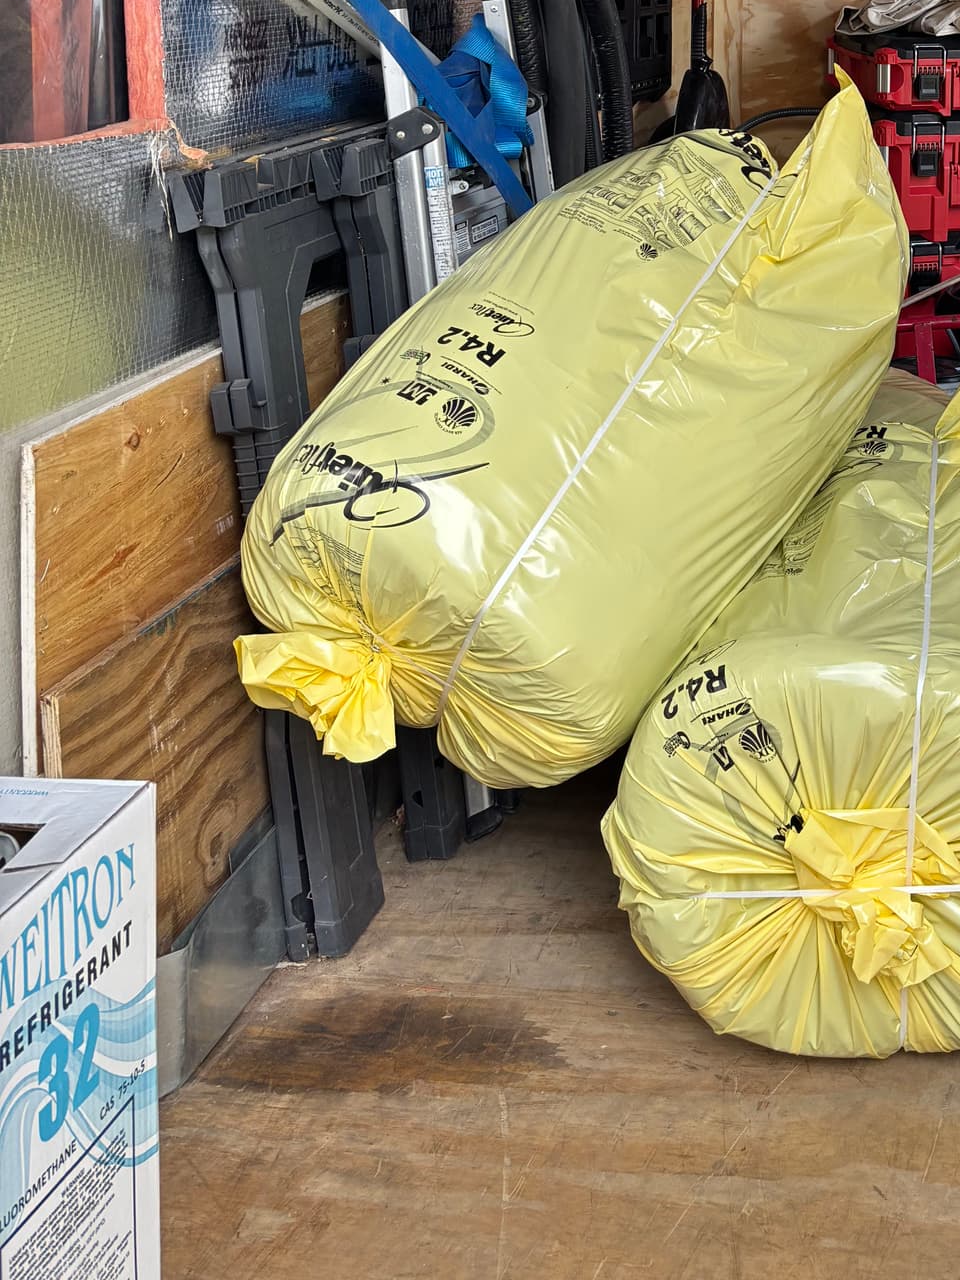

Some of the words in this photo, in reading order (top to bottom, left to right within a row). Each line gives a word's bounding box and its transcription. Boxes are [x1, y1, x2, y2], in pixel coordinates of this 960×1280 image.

[437, 326, 508, 368] R4.2
[295, 444, 431, 528] Quietfle
[661, 665, 729, 720] R4.2
[0, 919, 133, 1073] REFRIGERANT
[38, 1002, 100, 1143] 32
[100, 1098, 115, 1121] CAS
[117, 1058, 146, 1095] 75-10-5
